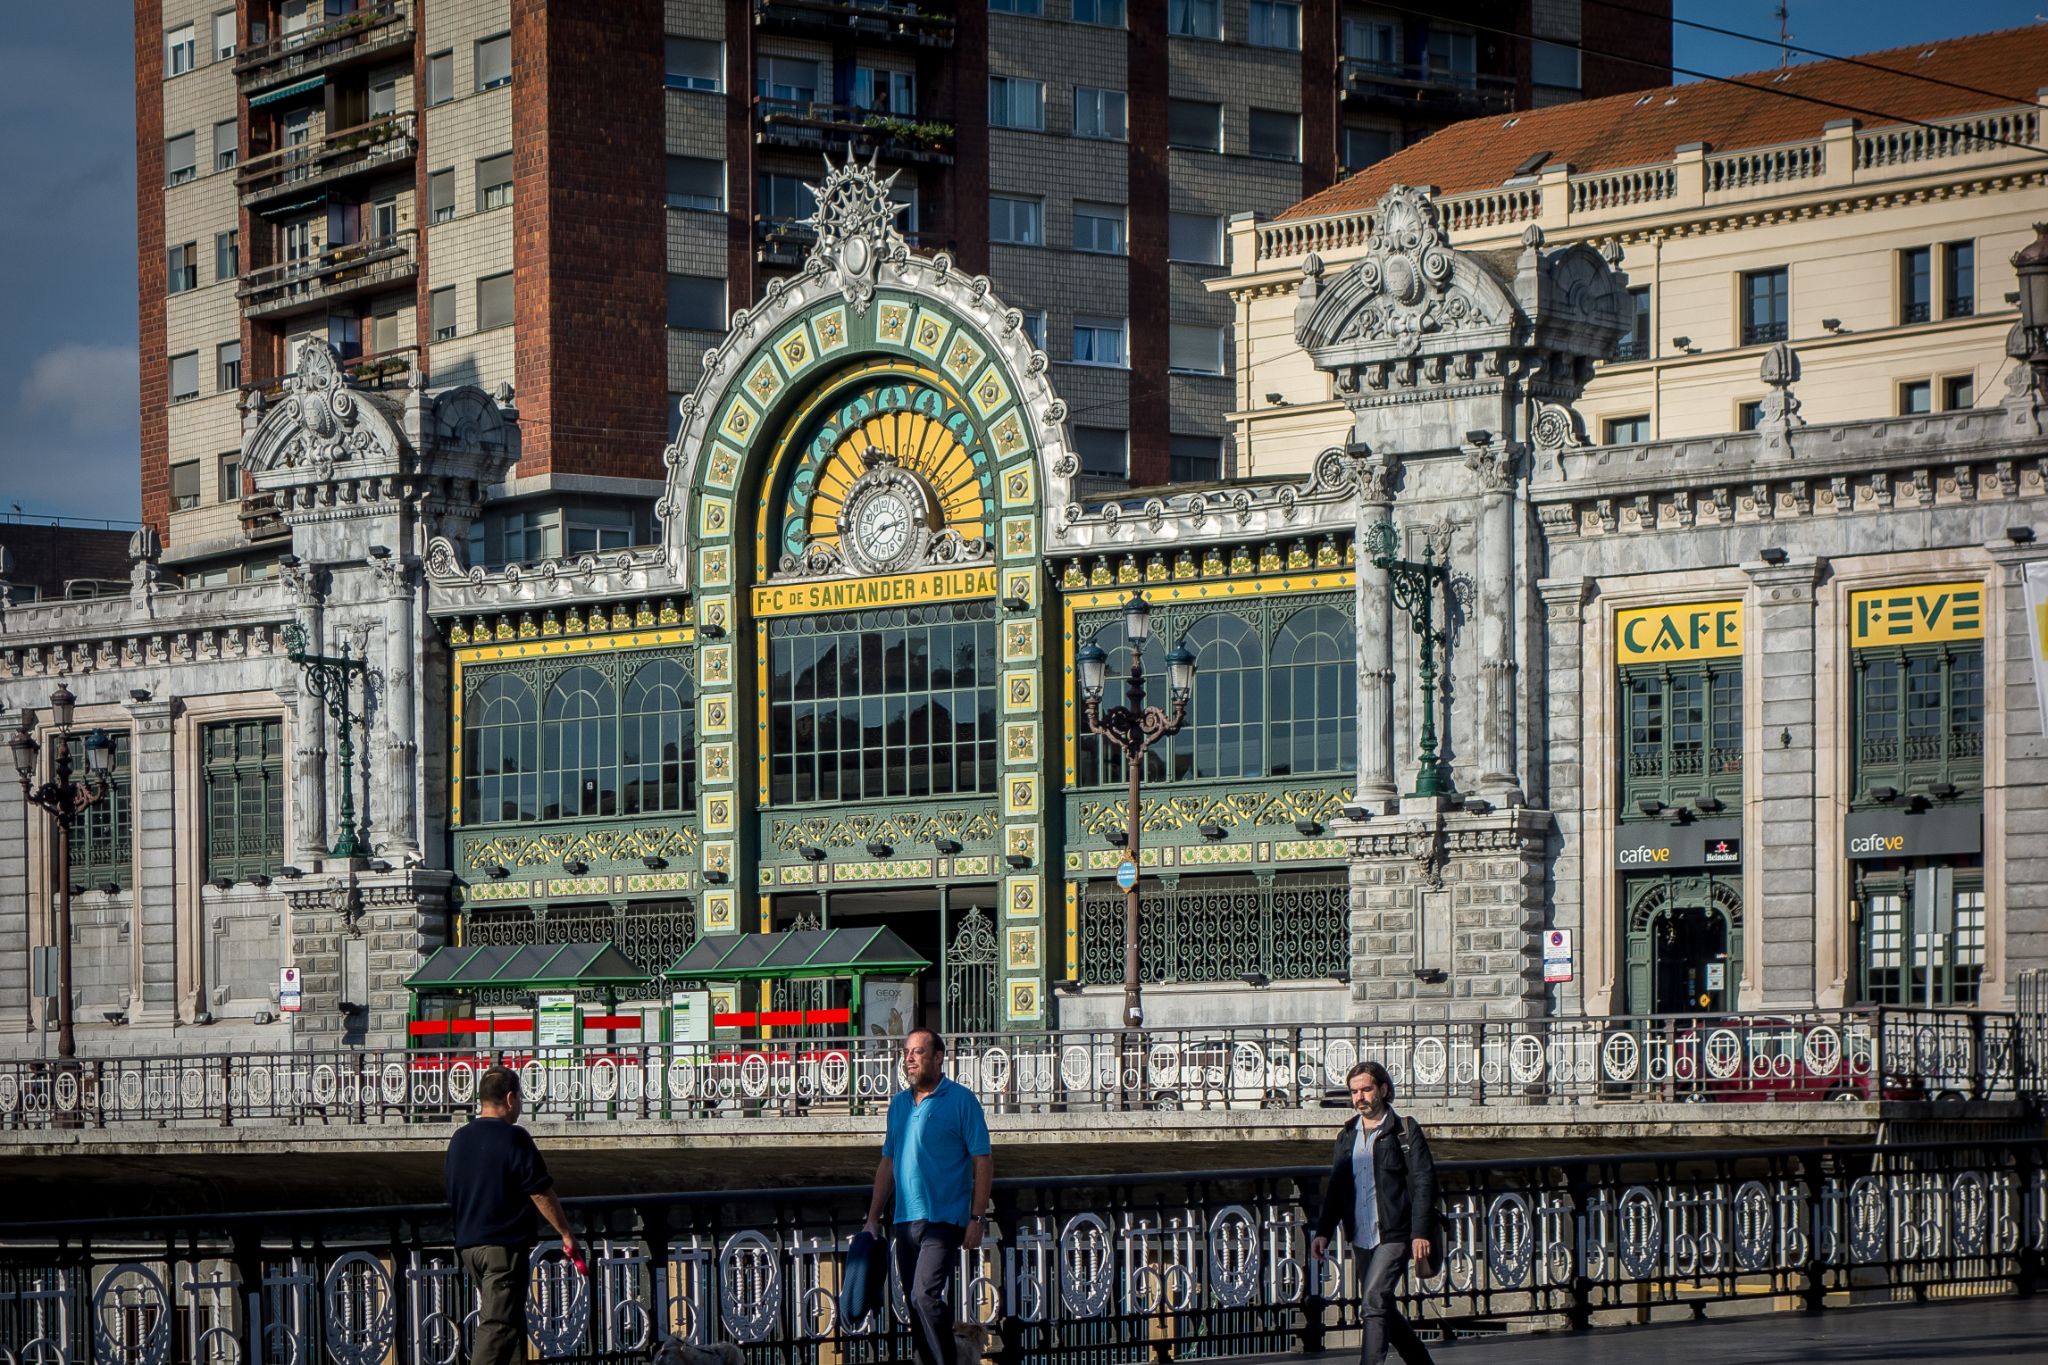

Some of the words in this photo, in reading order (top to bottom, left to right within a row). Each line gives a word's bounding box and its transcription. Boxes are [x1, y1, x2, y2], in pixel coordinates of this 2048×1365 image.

[881, 500, 888, 509] 12
[866, 513, 873, 521] 10
[897, 510, 903, 518] 2
[789, 592, 804, 606] DE
[809, 578, 915, 607] SANTANDER
[920, 581, 928, 594] A
[1858, 591, 1980, 638] FEVE
[1624, 610, 1739, 654] CAFE
[1851, 833, 1904, 852] cafeve
[1619, 845, 1670, 863] cafeve
[1706, 852, 1738, 862] Heineken
[876, 989, 902, 997] GEOX
